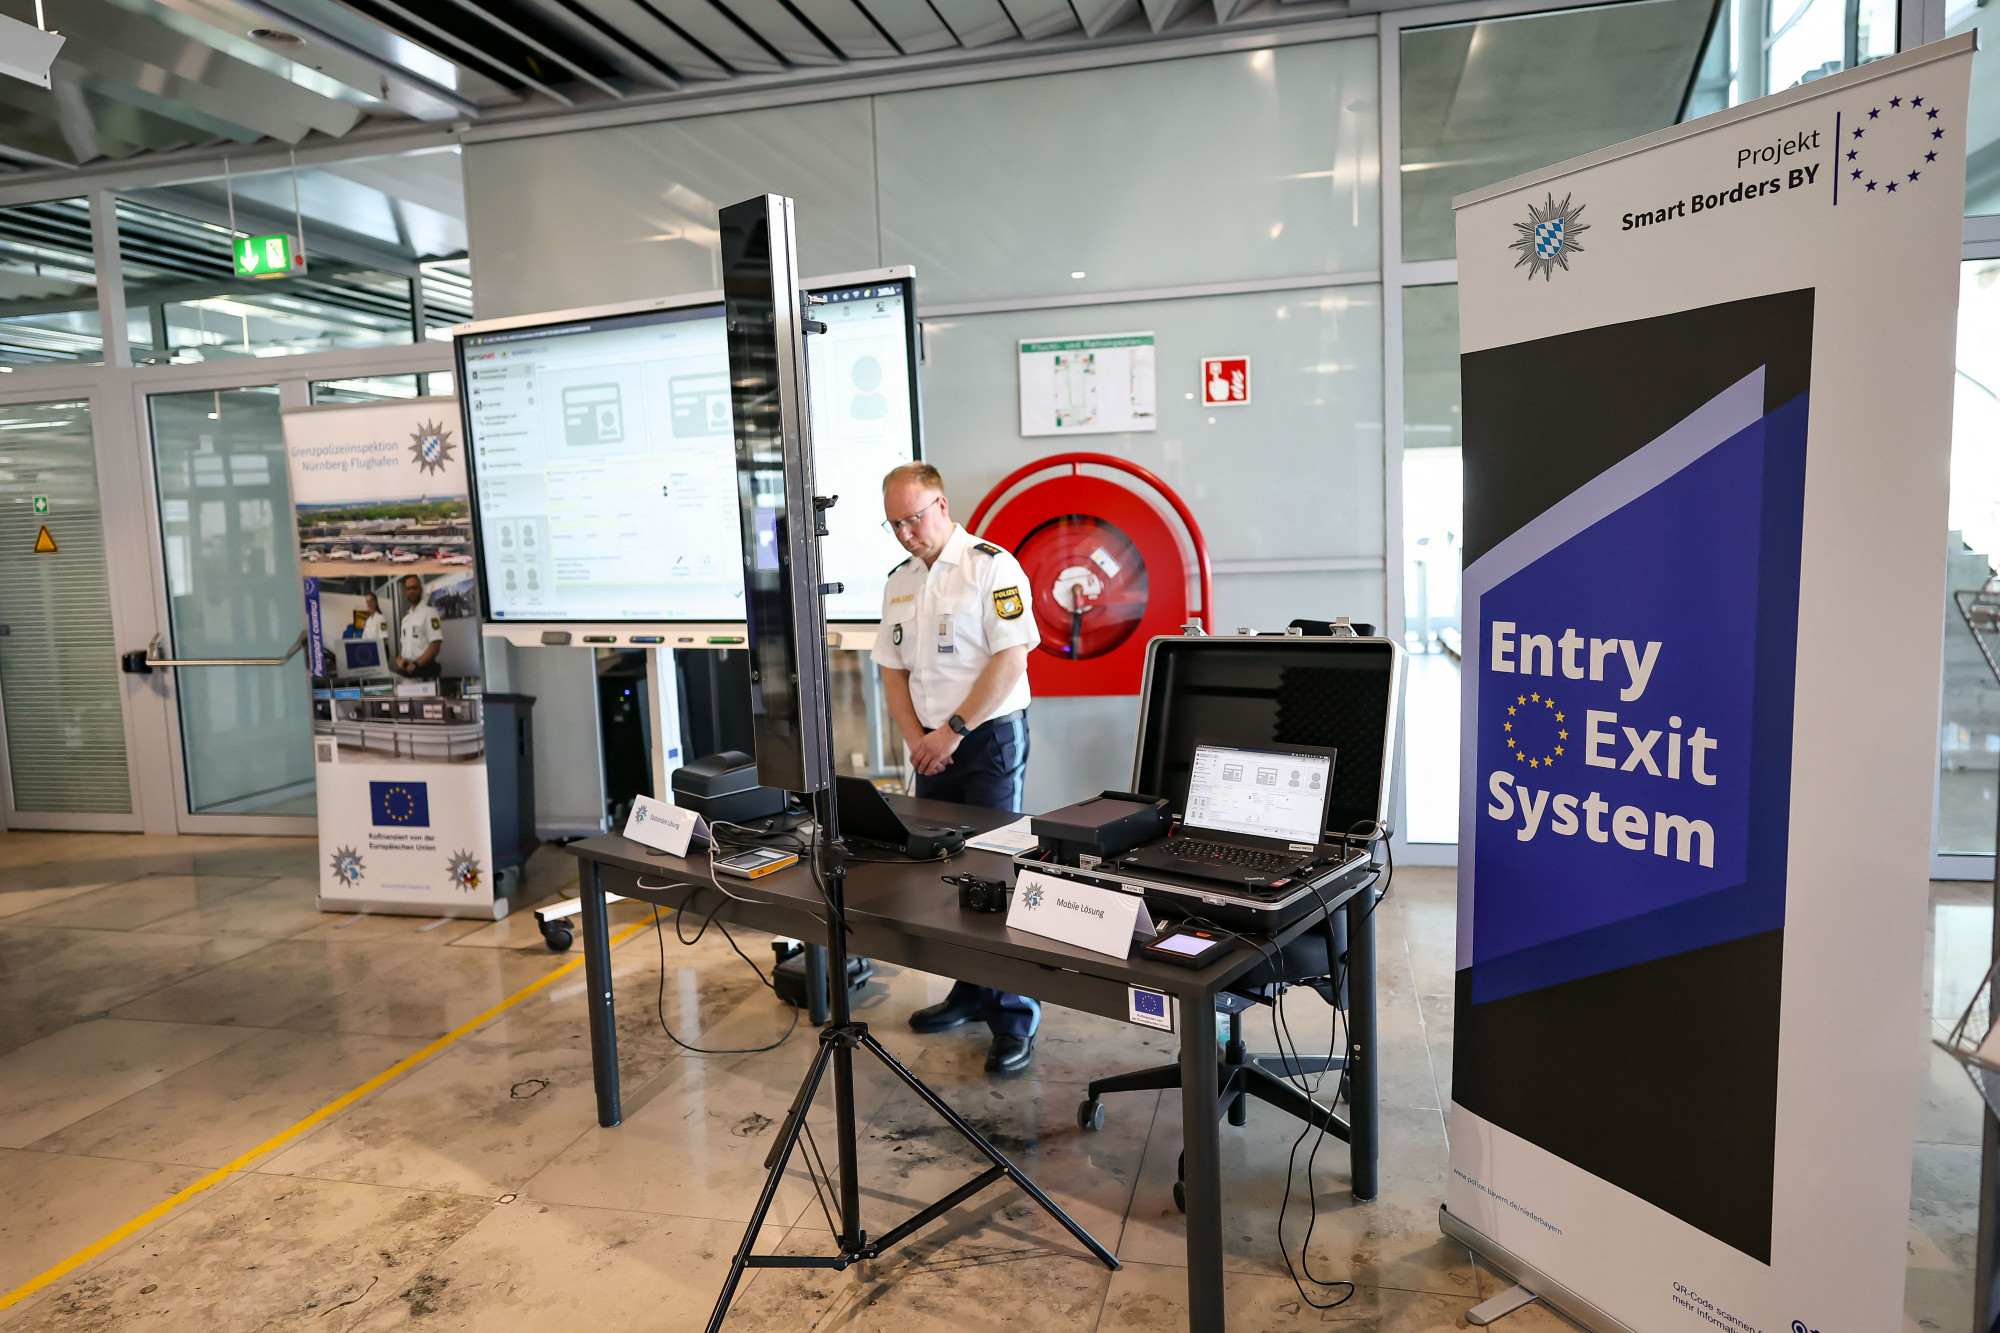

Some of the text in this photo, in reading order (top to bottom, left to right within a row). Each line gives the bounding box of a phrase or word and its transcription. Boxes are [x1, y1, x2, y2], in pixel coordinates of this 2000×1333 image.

[1737, 129, 1821, 169] Projekt
[1621, 163, 1821, 231] Smart Borders BY
[291, 441, 398, 458] Grenzpolizeiinspektion
[890, 594, 914, 604] POLIZEI
[994, 588, 1019, 599] POLIZEI
[1491, 620, 1663, 702] Entry
[1585, 709, 1718, 786] Exit
[1488, 770, 1715, 869] System
[1056, 898, 1104, 919] Mobile Lösung
[1453, 1167, 1563, 1236] www.polizei.bayern.de/niederbayern
[1672, 1294, 1695, 1312] mehr
[1673, 1281, 1756, 1333] QR-Code scannen
